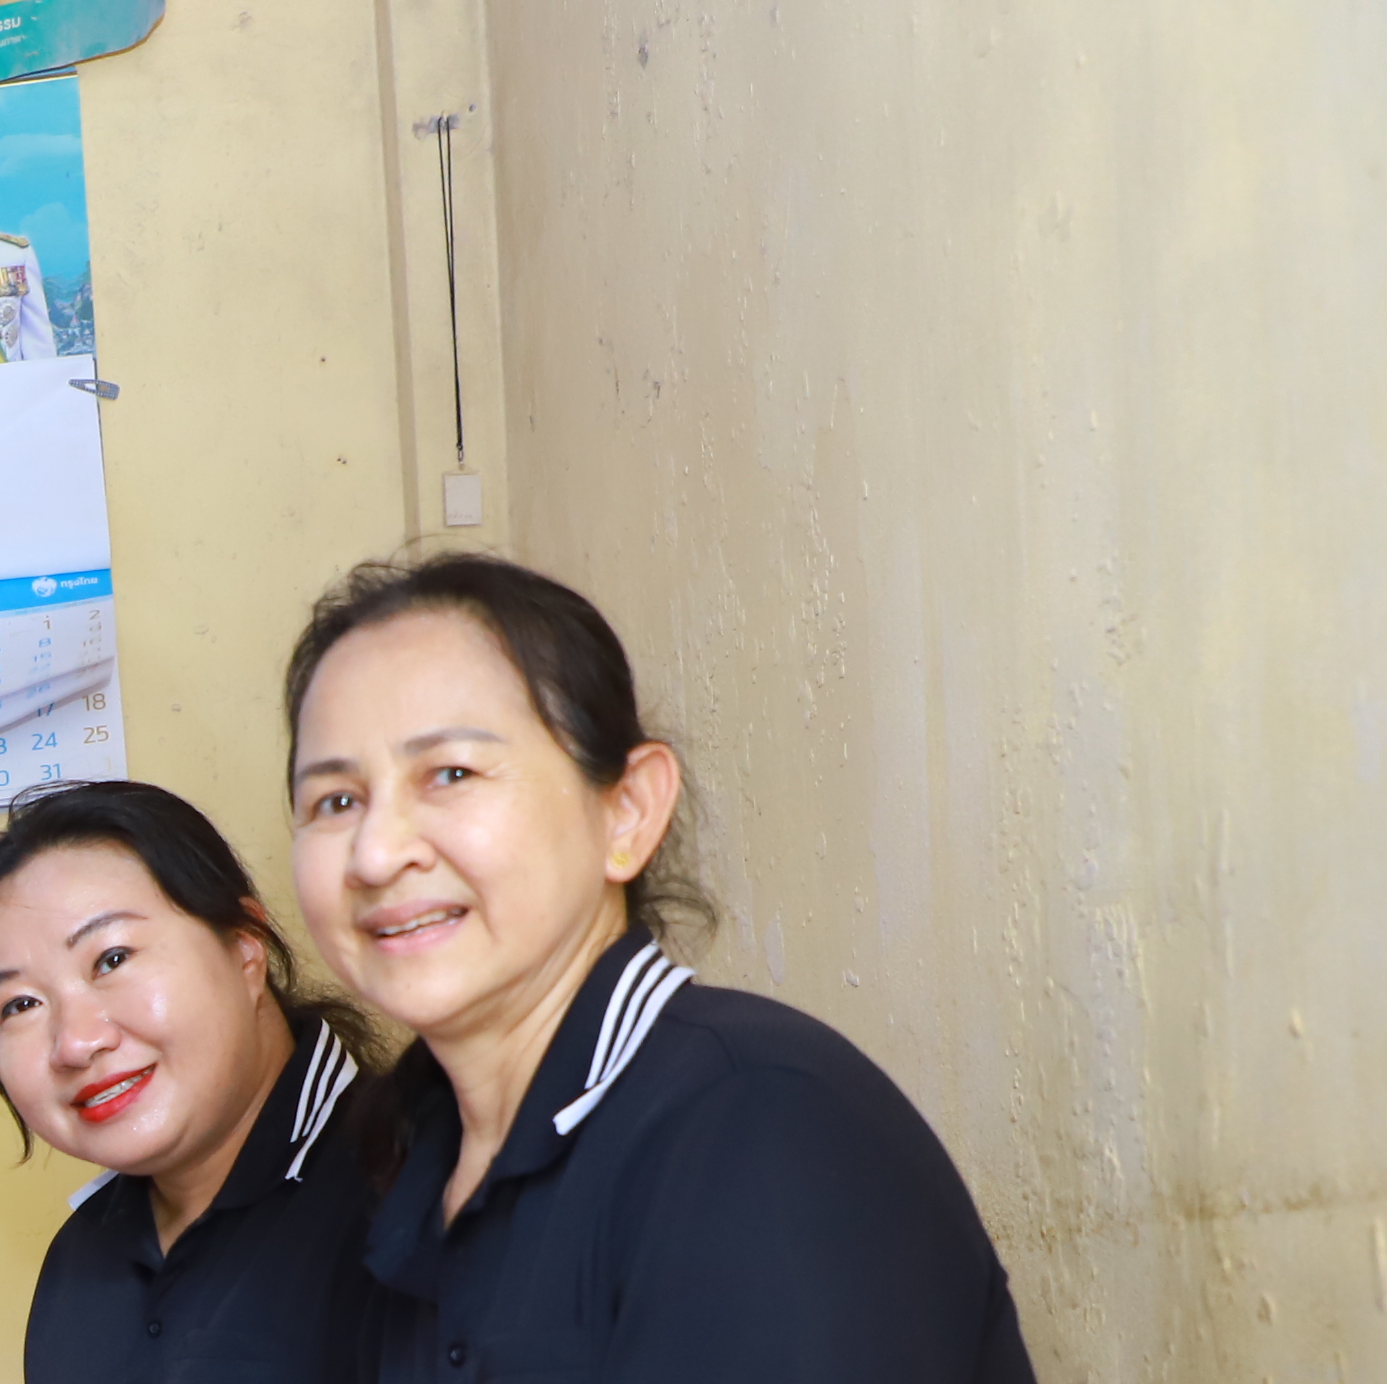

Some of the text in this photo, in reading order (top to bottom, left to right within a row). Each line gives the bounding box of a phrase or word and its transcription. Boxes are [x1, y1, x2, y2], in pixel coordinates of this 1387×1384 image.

[38, 637, 52, 648] 8
[82, 693, 106, 711] 18
[32, 732, 58, 751] 24
[83, 725, 109, 744] 25
[40, 763, 62, 781] 31
